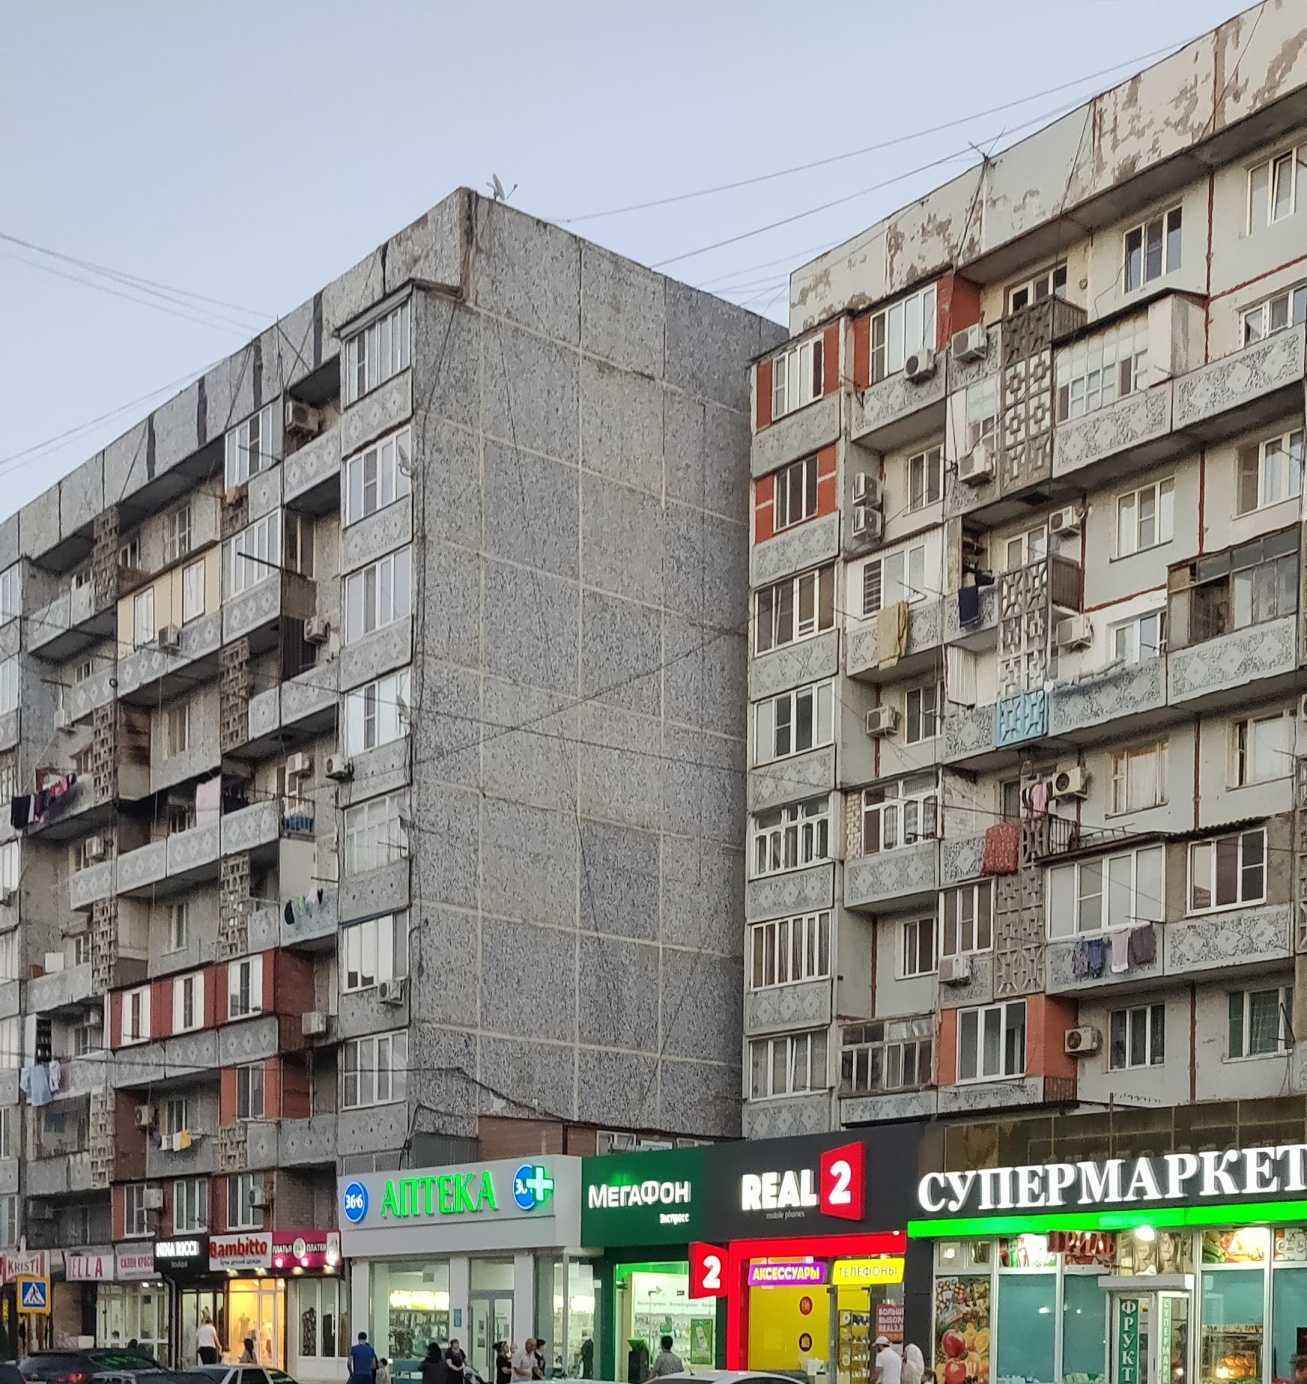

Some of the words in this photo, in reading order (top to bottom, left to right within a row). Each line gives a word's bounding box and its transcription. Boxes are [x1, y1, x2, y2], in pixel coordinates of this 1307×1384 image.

[380, 1168, 498, 1218] АПТЕКА
[741, 1169, 818, 1211] REAL
[828, 1160, 852, 1205] 2
[917, 1143, 1307, 1212] СУПЕРМАРКЕТ
[208, 1236, 268, 1259] Bambitto
[702, 1255, 722, 1289] 2
[752, 1266, 820, 1281] АКСЕССУАРЫ
